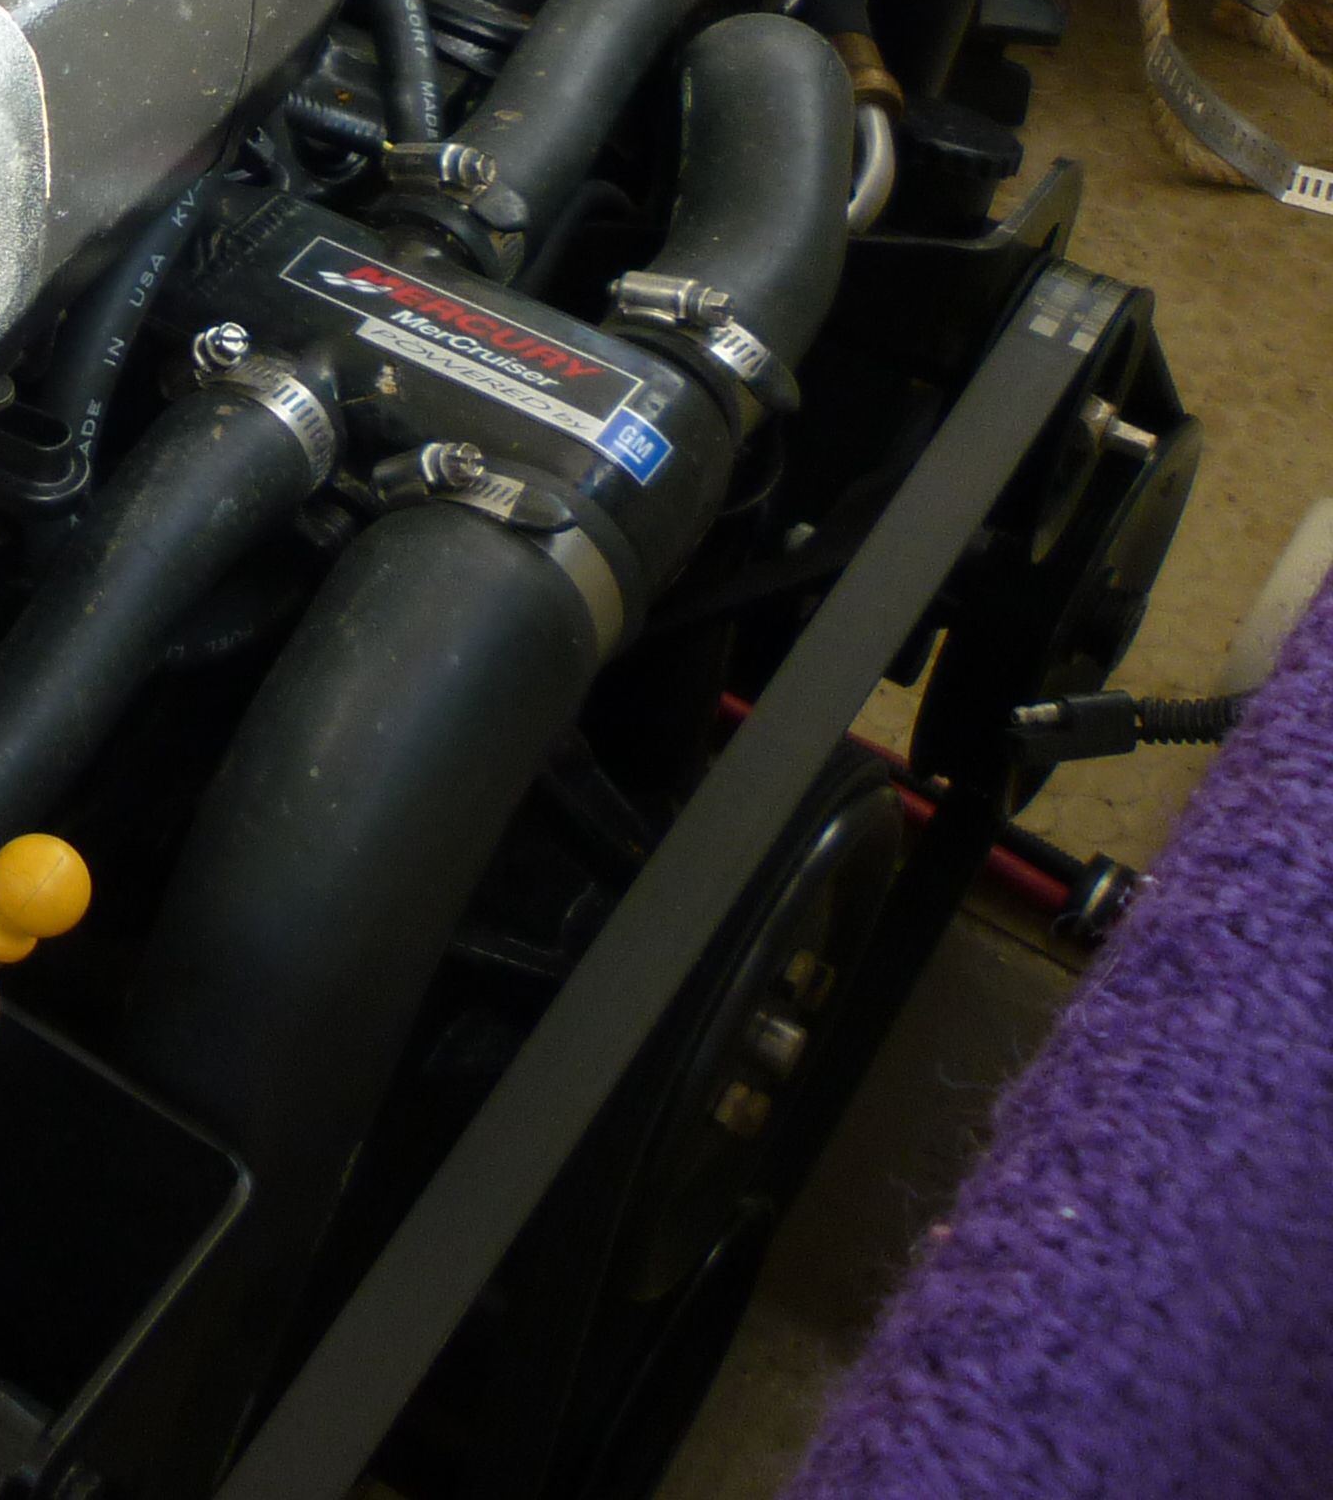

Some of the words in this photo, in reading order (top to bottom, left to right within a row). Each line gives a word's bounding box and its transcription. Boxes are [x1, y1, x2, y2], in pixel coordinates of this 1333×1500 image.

[76, 397, 104, 456] ADE
[102, 335, 126, 367] IN
[128, 252, 166, 309] USA
[344, 265, 605, 380] MERCURY
[388, 309, 562, 390] MerCruiser
[370, 327, 553, 414] POWERED
[617, 423, 656, 460] GM
